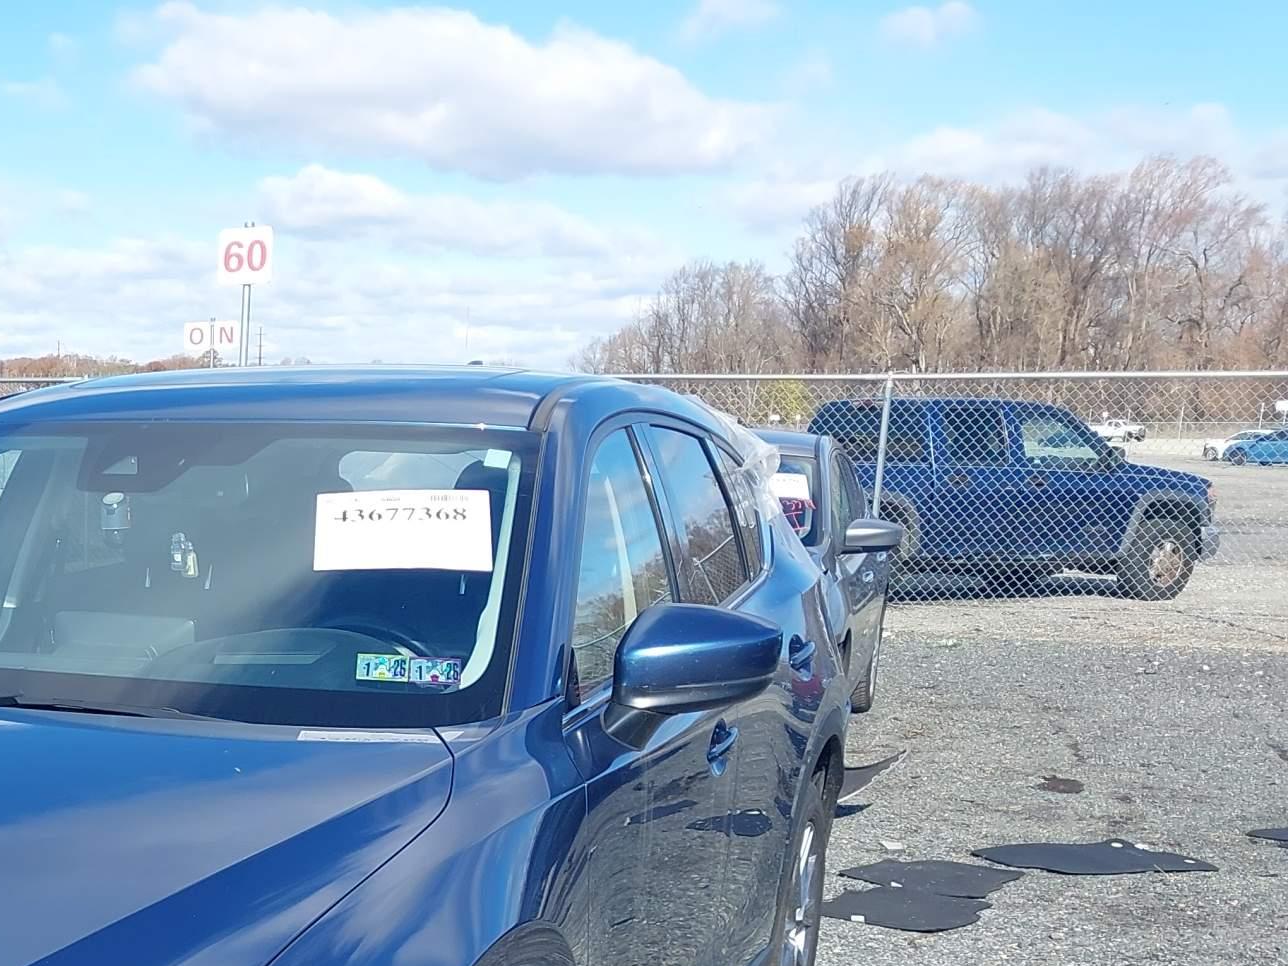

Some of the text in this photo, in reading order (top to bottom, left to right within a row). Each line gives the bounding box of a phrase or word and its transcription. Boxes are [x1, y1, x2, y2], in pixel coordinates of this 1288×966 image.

[223, 239, 267, 272] 60
[189, 326, 234, 345] O N
[333, 506, 468, 522] 43677368
[393, 660, 407, 676] 26
[446, 662, 459, 680] 26
